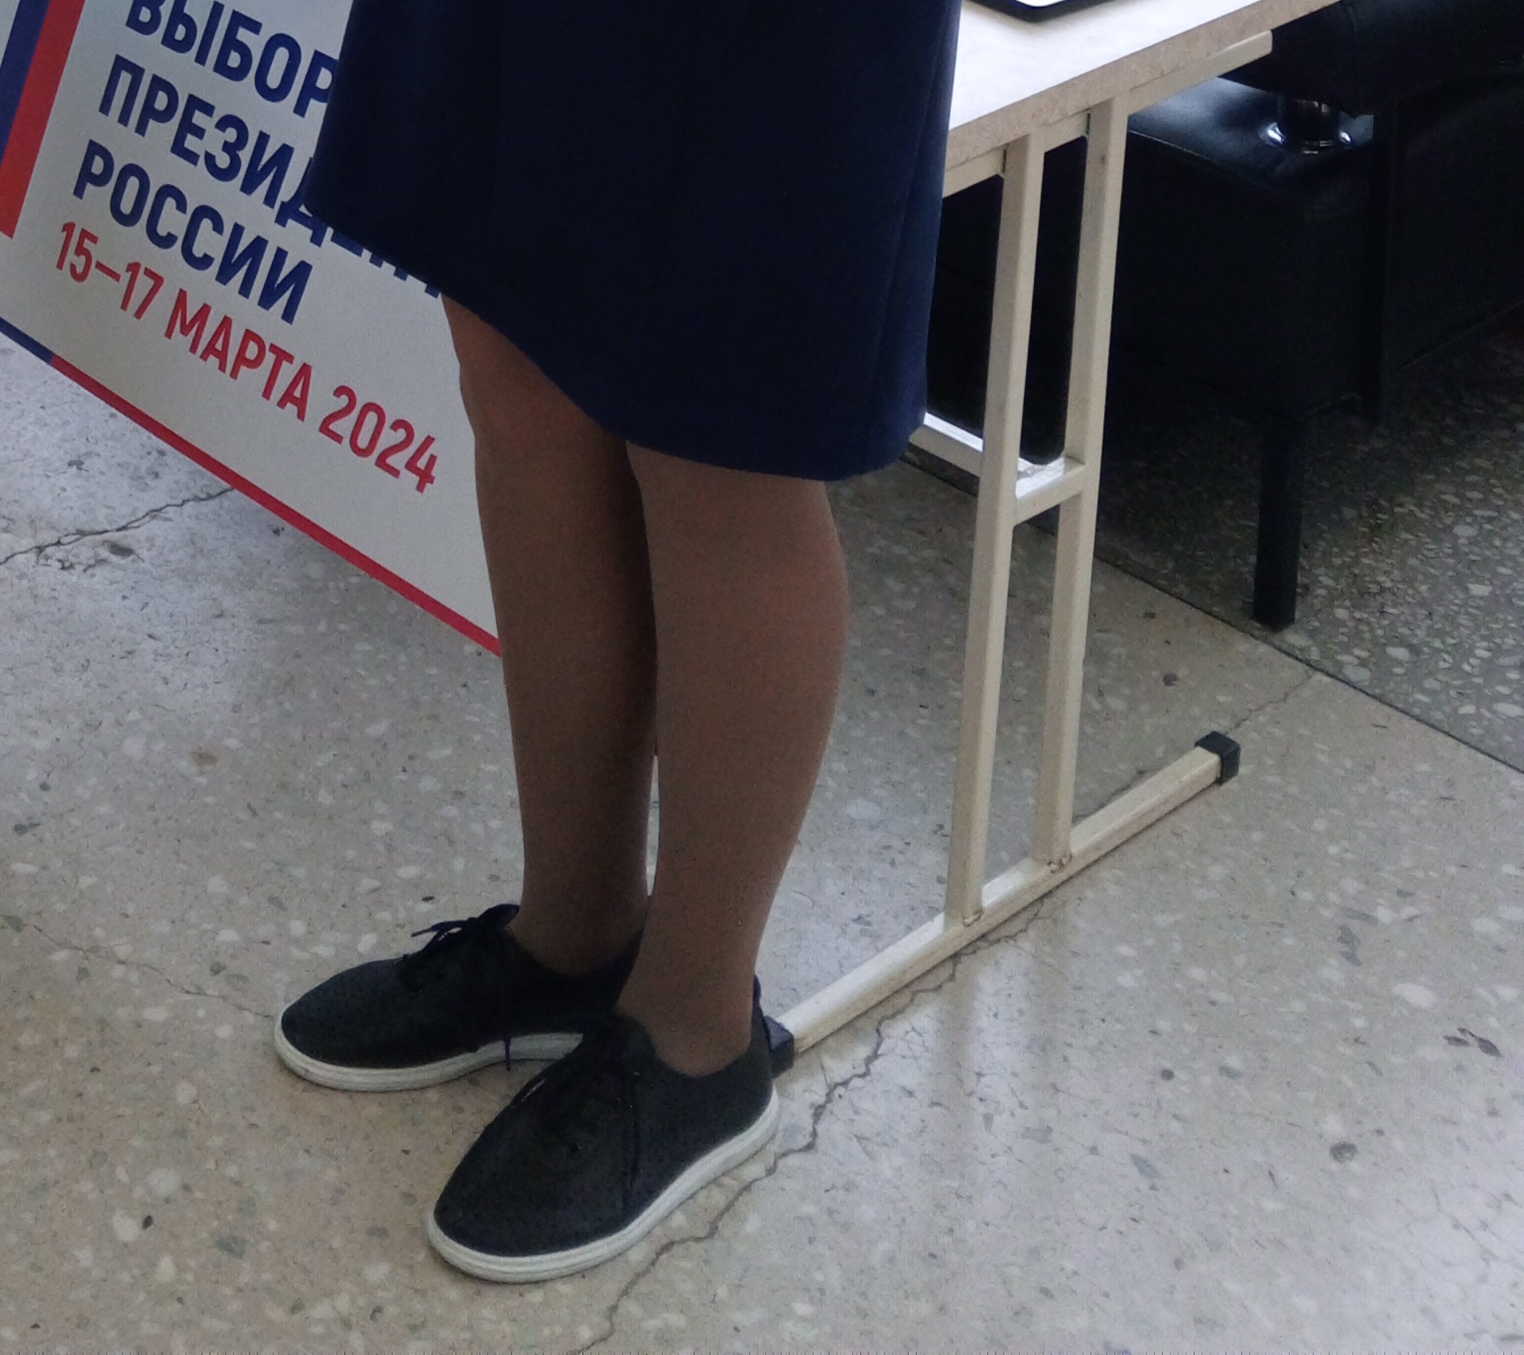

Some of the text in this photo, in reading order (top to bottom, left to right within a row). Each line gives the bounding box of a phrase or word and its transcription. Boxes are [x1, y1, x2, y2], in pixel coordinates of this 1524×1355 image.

[72, 138, 313, 325] РОССИИ
[164, 288, 312, 422] МАРТА
[318, 384, 437, 494] 2024
